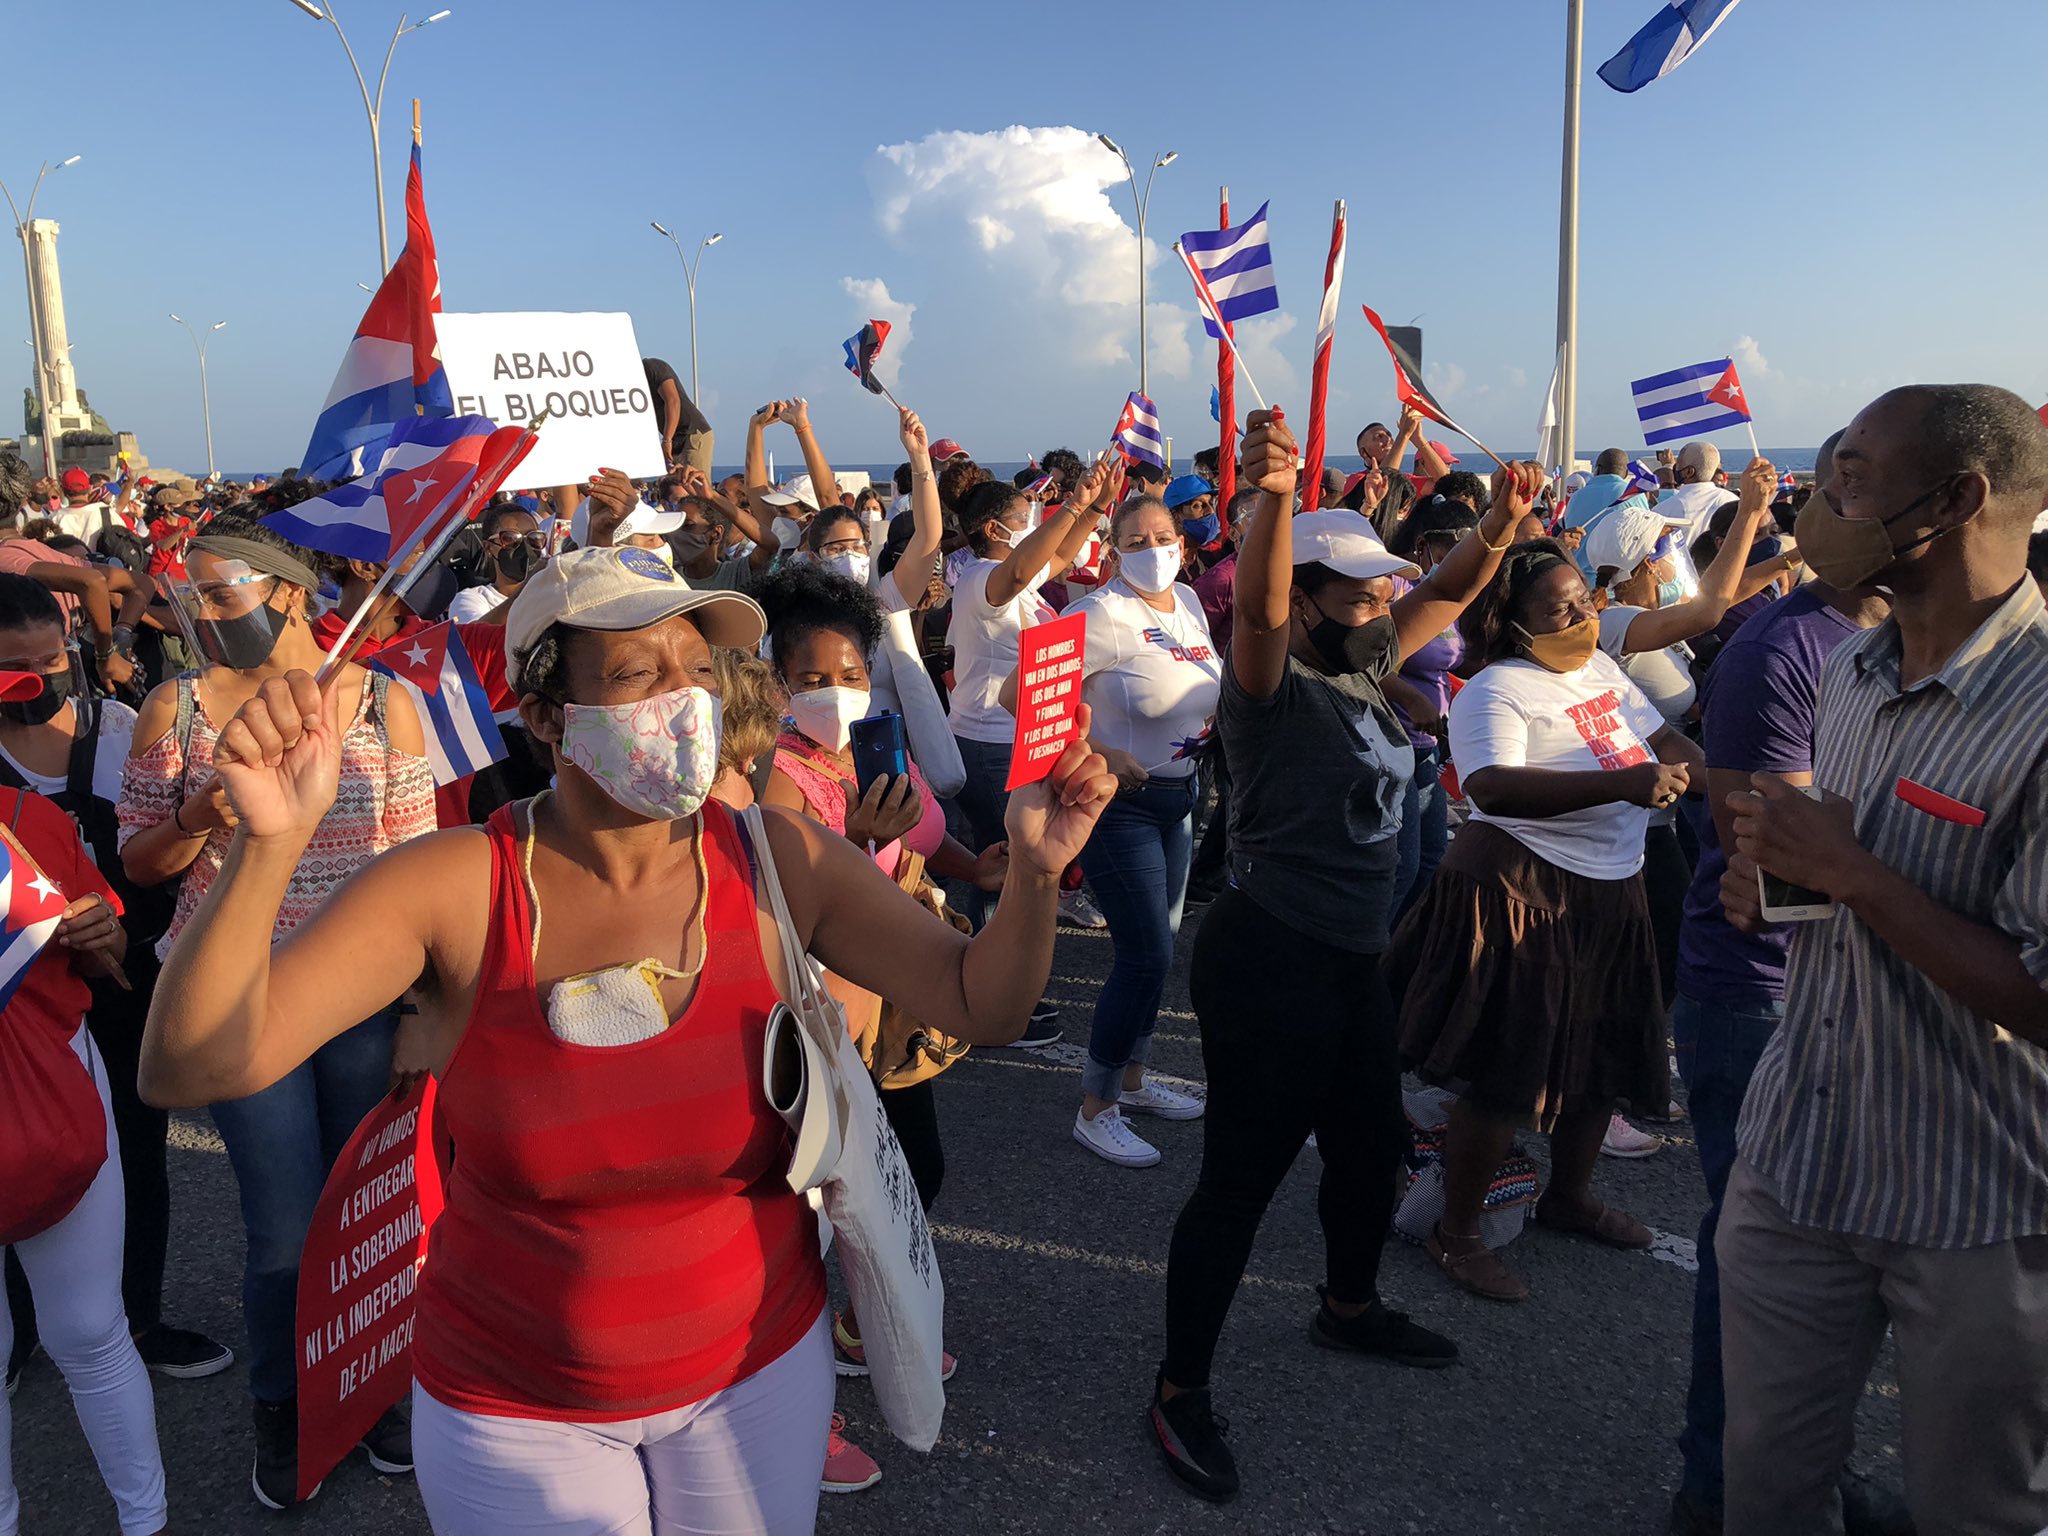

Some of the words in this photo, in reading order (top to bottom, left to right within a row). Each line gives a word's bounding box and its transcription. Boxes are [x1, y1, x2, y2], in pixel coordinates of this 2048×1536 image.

[493, 350, 594, 380] ABAJO
[457, 395, 499, 422] EL
[505, 387, 648, 421] BLOQUEO
[1035, 647, 1048, 664] LOS
[1048, 639, 1075, 660] HOMBRES
[1169, 645, 1214, 662] CUBA
[1025, 670, 1036, 687] VAN
[1037, 666, 1046, 683] EN
[1046, 664, 1058, 681] DOS
[1032, 688, 1043, 705] LOS
[1044, 685, 1056, 701] QUE
[1056, 679, 1072, 697] AMAN
[1035, 709, 1040, 722] Y
[1024, 732, 1029, 746] Y
[1029, 728, 1041, 744] LOS
[1041, 724, 1054, 740] QUE
[1054, 717, 1072, 736] ODIAN
[1028, 748, 1034, 762] Y
[1034, 738, 1066, 761] DESHACEN
[357, 1133, 380, 1171] NO
[378, 1105, 419, 1156] VAMOS
[340, 1196, 350, 1232] A
[353, 1154, 415, 1223] ENTREGAR
[331, 1254, 348, 1294] LA
[352, 1200, 426, 1279] SOBERANÍA,
[306, 1327, 322, 1369] NI
[327, 1314, 346, 1355] LA
[339, 1359, 359, 1402] DE
[360, 1345, 376, 1384] LA
